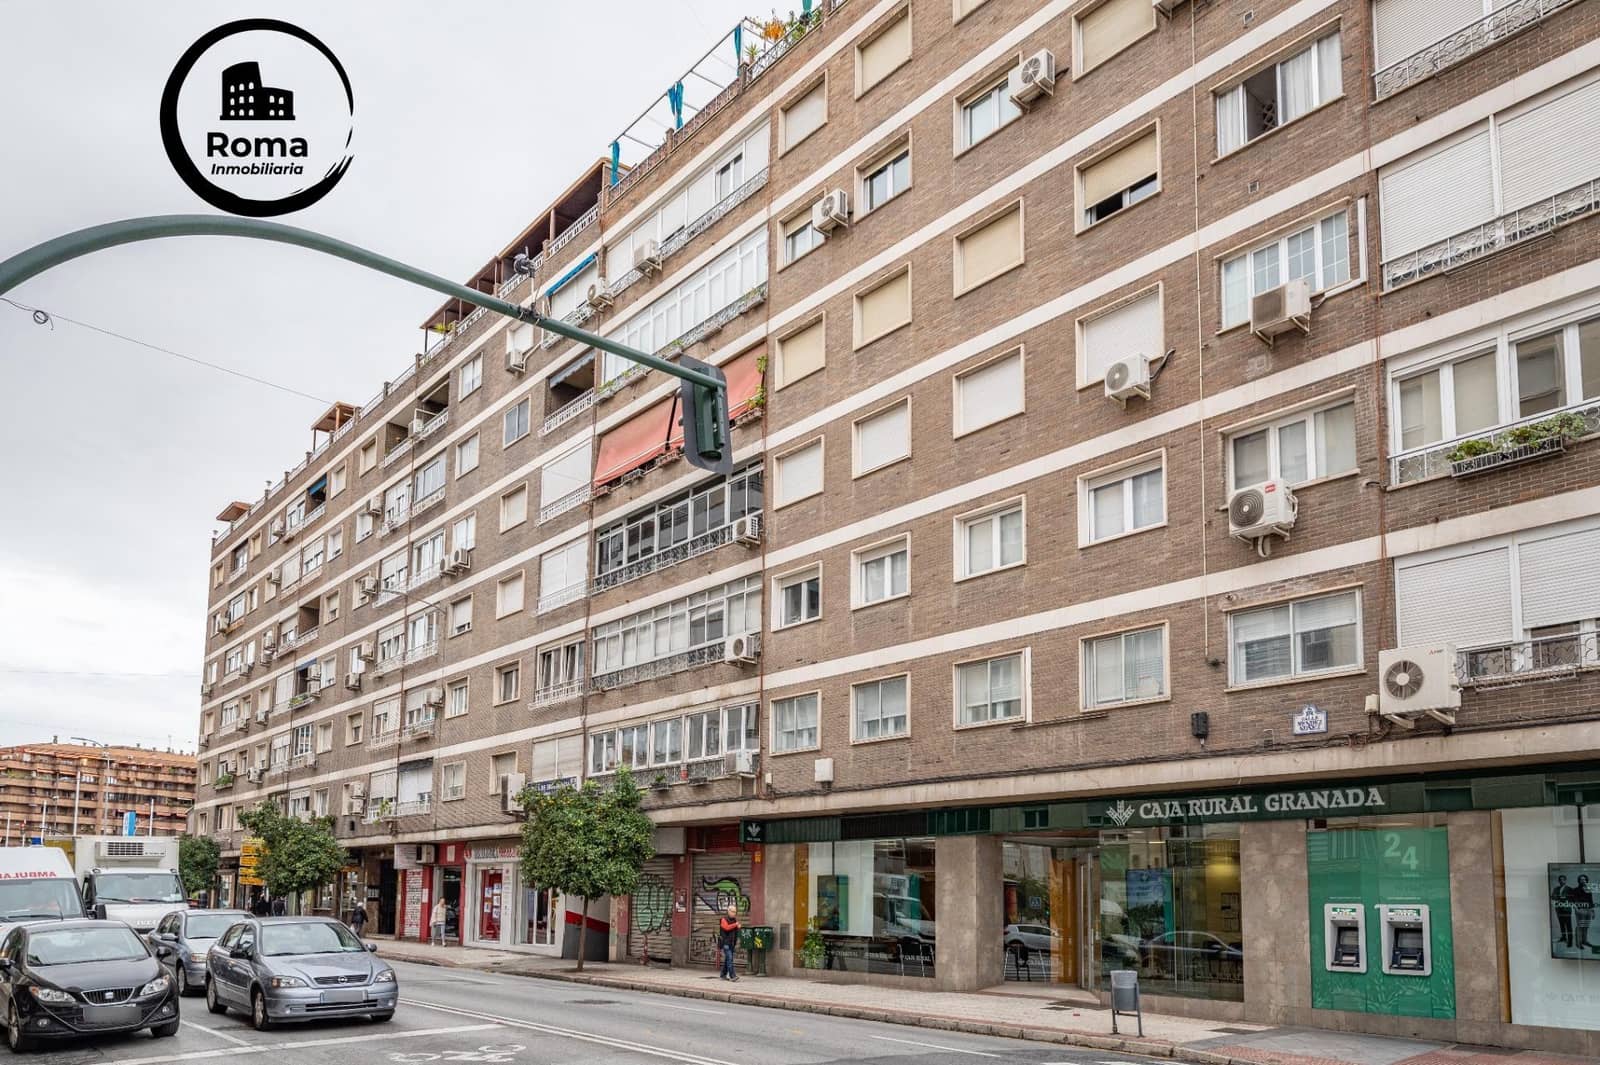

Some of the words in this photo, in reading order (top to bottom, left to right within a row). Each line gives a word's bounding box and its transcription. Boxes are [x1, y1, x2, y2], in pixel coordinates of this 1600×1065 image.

[1139, 800, 1184, 820] CAJA
[1188, 795, 1257, 817] RURAL
[1264, 787, 1385, 812] GRANADA
